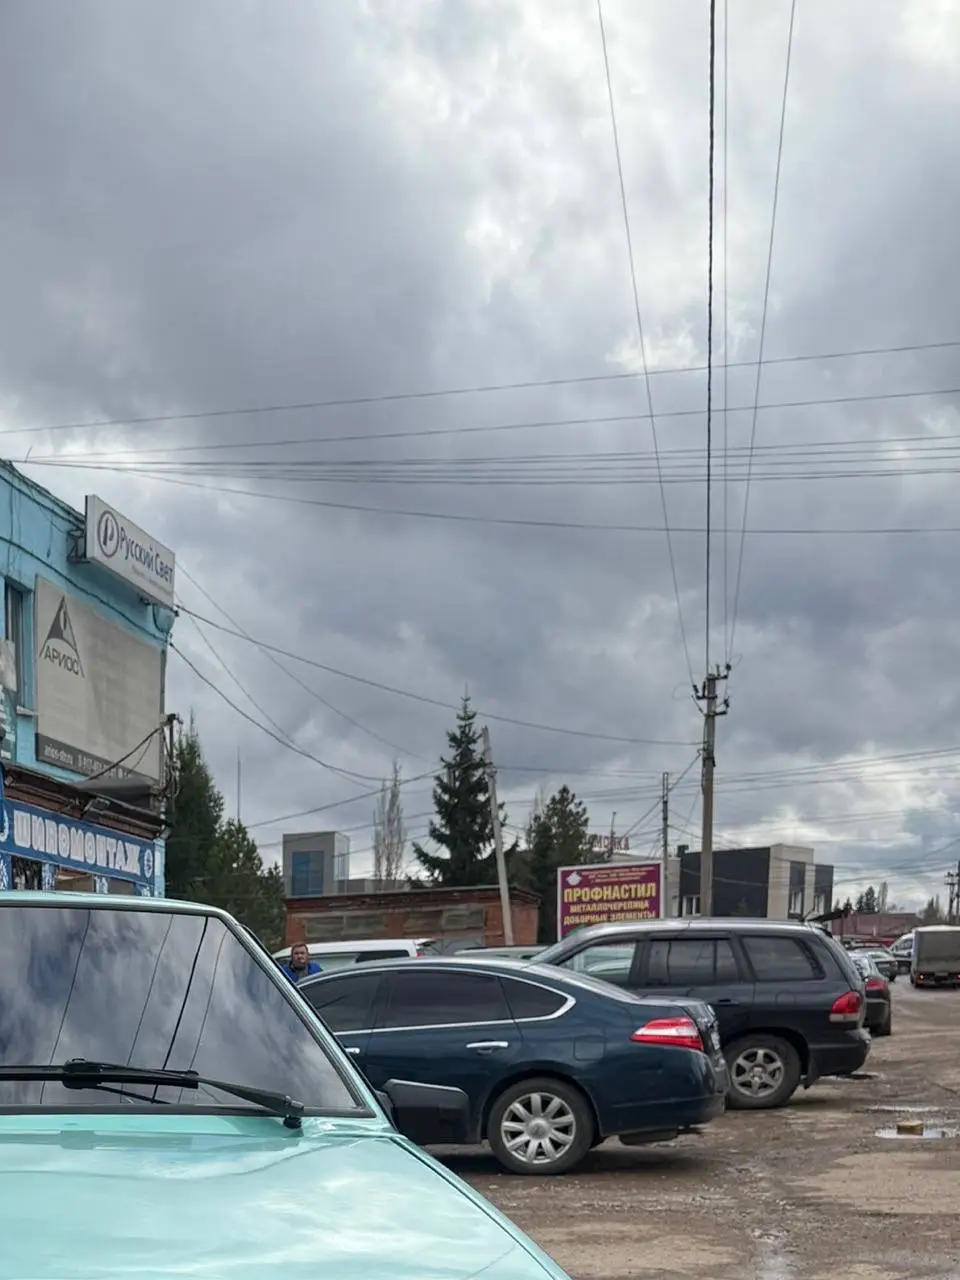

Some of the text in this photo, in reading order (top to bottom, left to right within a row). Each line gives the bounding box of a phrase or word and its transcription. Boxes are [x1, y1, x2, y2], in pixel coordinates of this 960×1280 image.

[120, 526, 154, 573] Русский
[154, 552, 174, 584] Свет
[564, 883, 656, 902] ПРОФНАСТИЛ
[570, 900, 649, 914] МЕТАЛЛОЧЕРЕПИЦА
